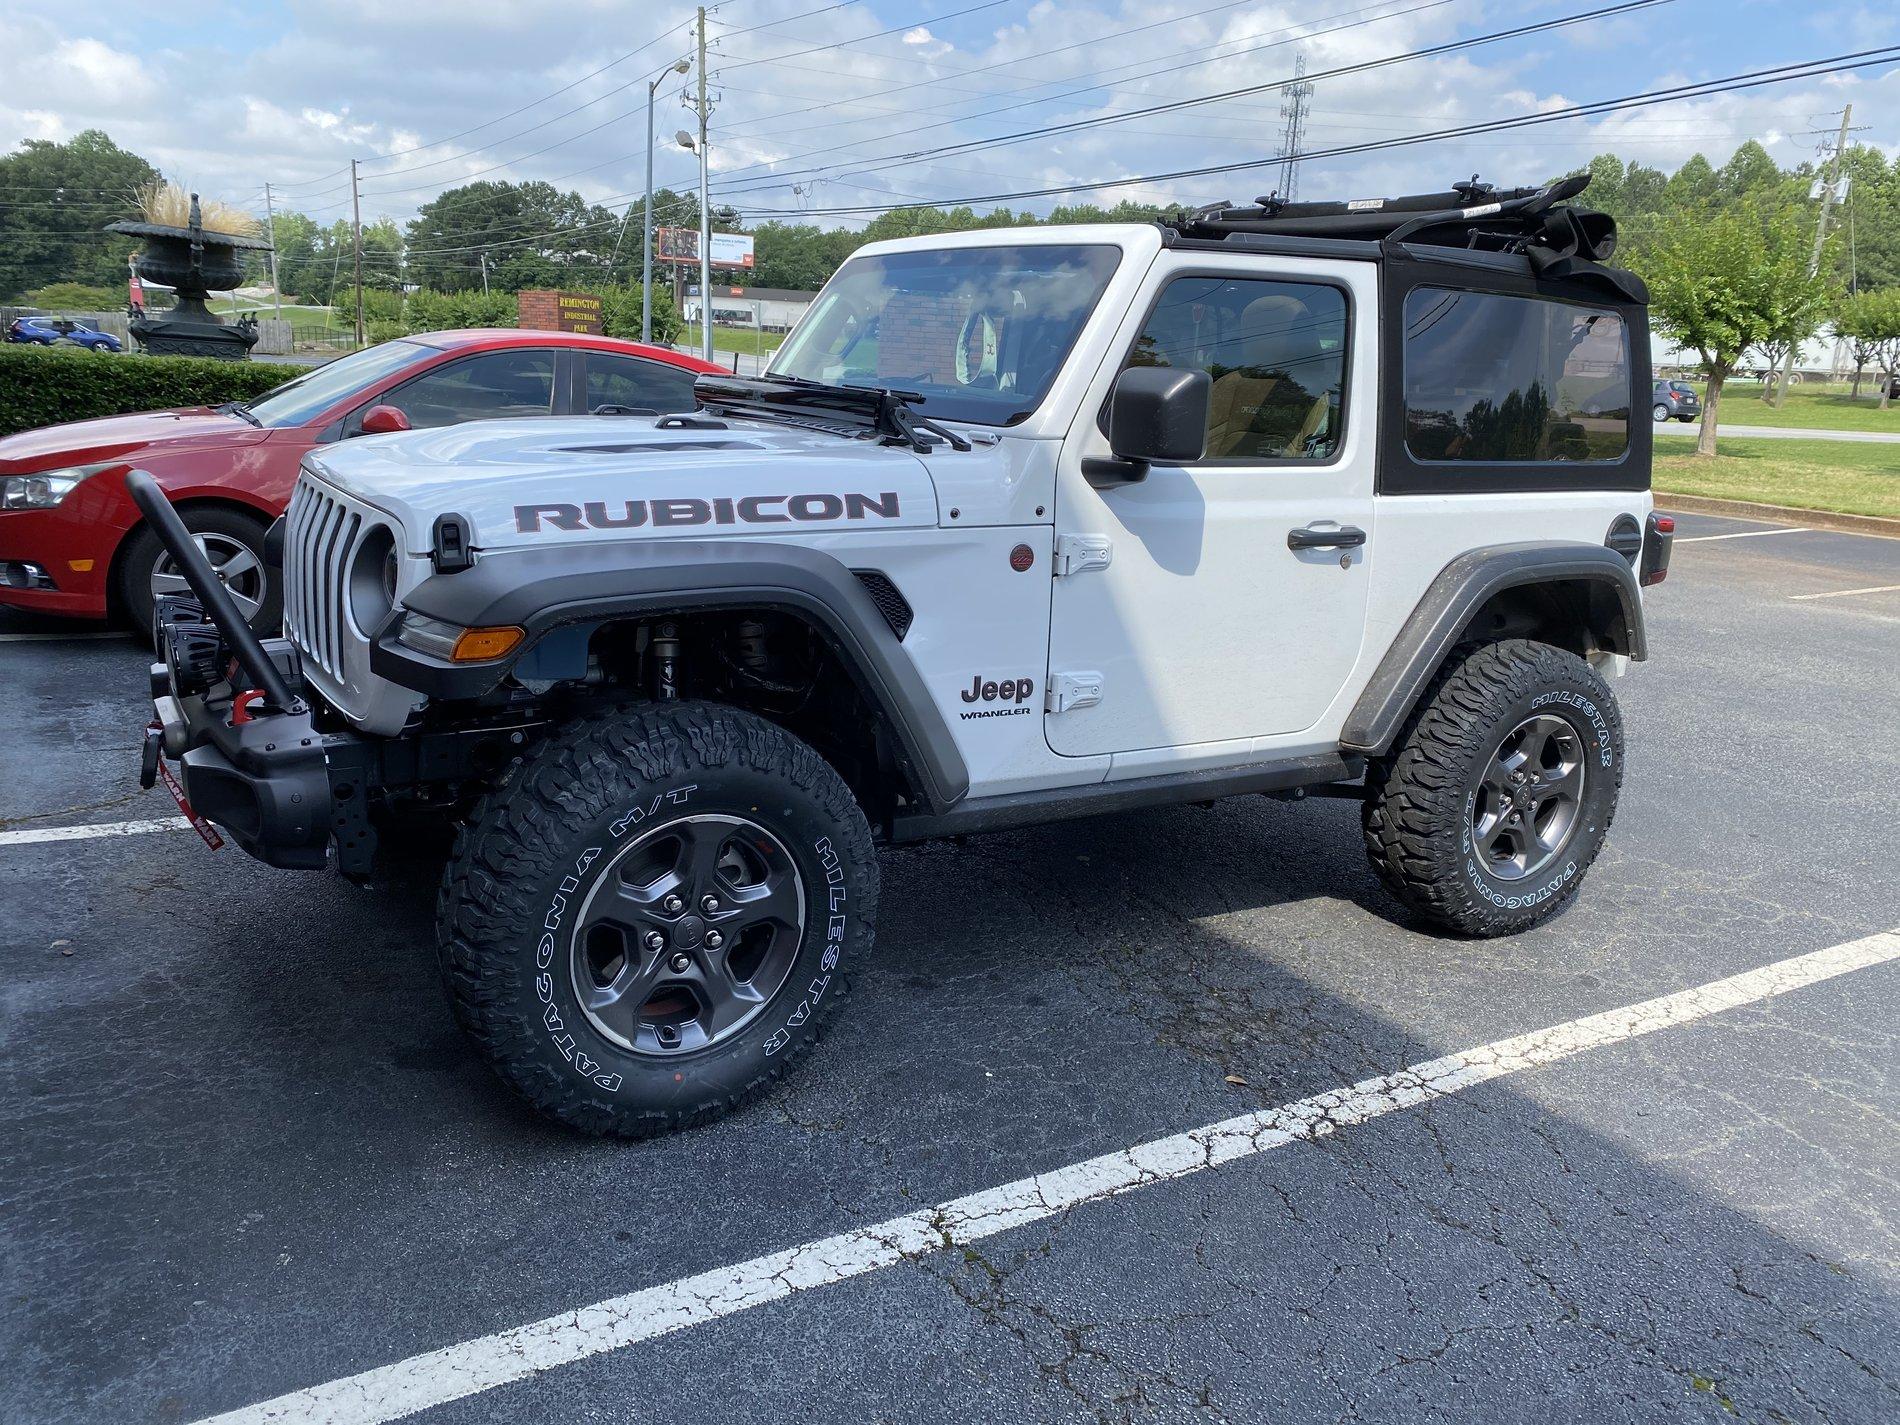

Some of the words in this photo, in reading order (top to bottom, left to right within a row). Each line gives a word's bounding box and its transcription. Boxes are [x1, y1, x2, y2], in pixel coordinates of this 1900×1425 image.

[559, 297, 600, 309] REMINGTON
[564, 312, 597, 321] INDUSTRIAL
[573, 325, 588, 333] PARK
[513, 491, 902, 534] RUBICON
[961, 675, 1034, 704] Jeep
[960, 707, 1031, 721] WRANGLER
[1531, 690, 1613, 768] MILESTAR
[609, 785, 697, 837] M/T
[1466, 859, 1578, 910] PATAGONIA
[763, 836, 847, 1057] MILESTAR
[535, 846, 623, 1093] PATAGONIA
